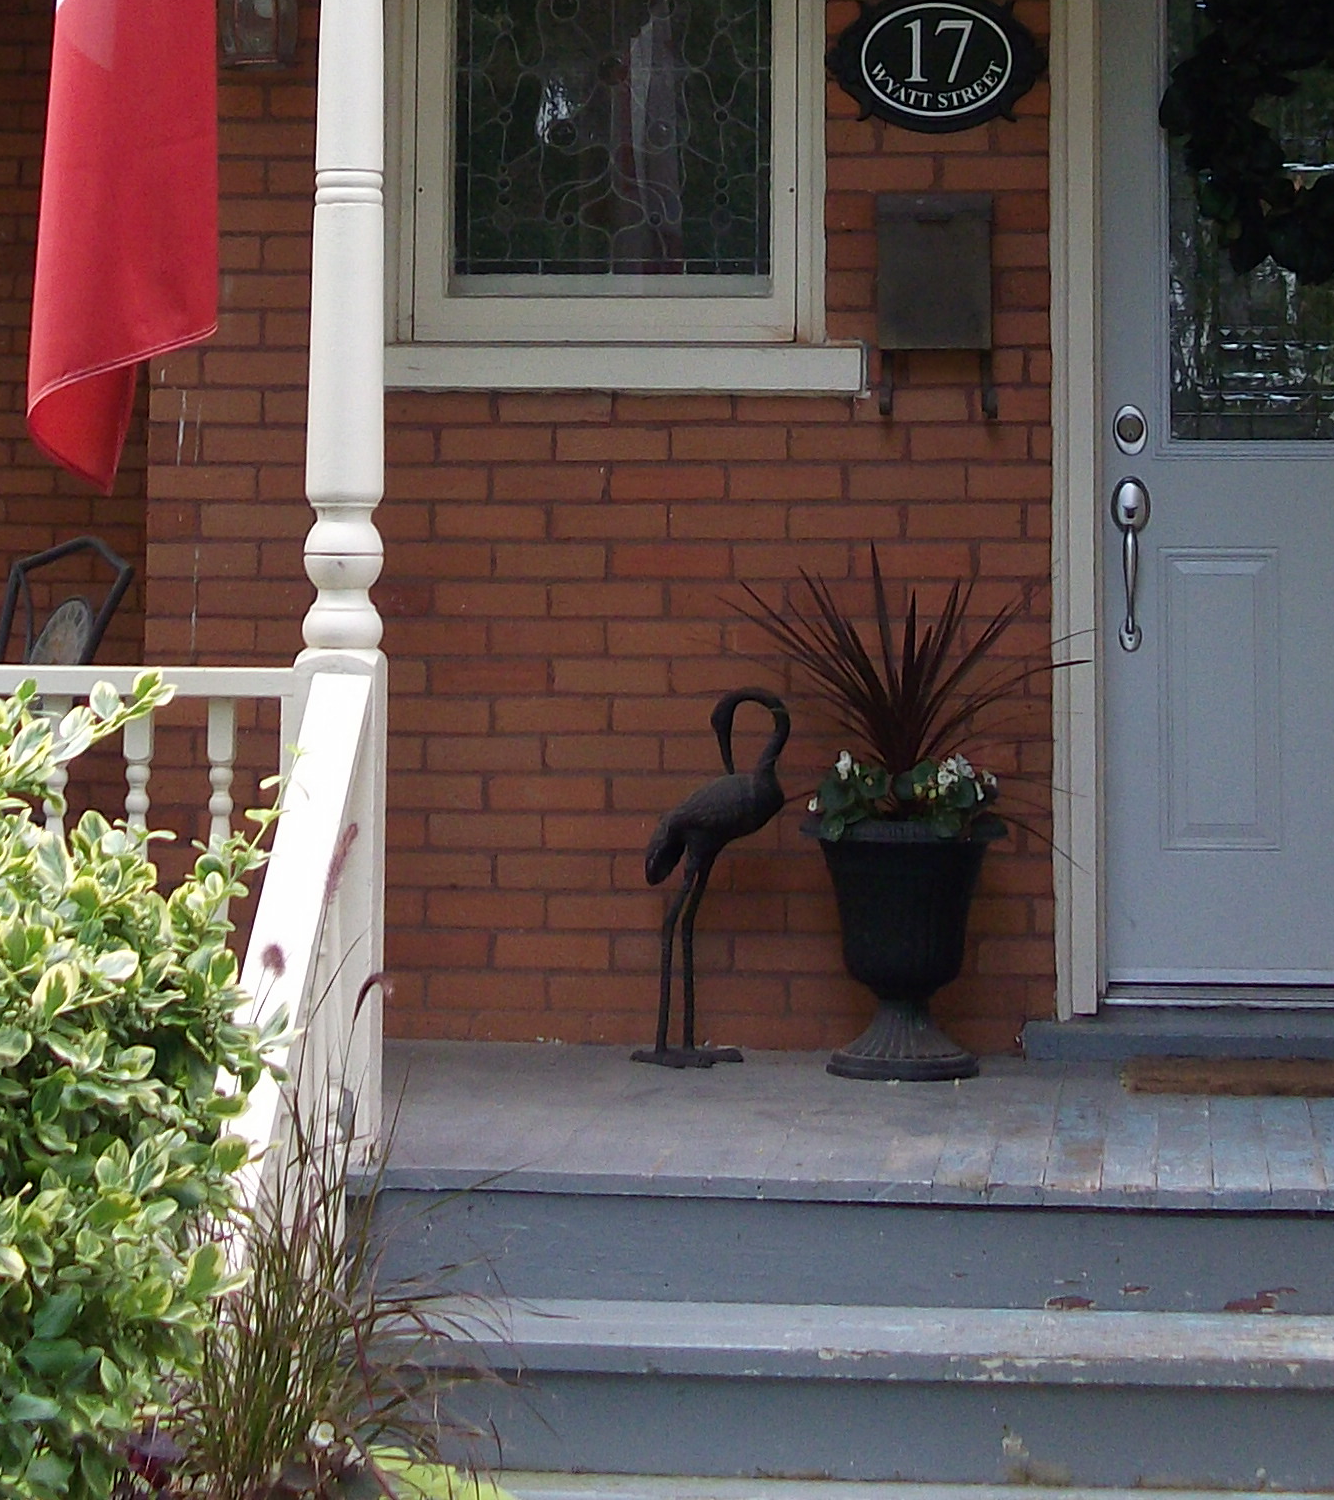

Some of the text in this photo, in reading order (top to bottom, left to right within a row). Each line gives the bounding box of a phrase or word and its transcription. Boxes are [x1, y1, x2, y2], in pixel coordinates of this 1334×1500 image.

[903, 18, 974, 84] 17
[871, 60, 1004, 109] WYATT STREET
